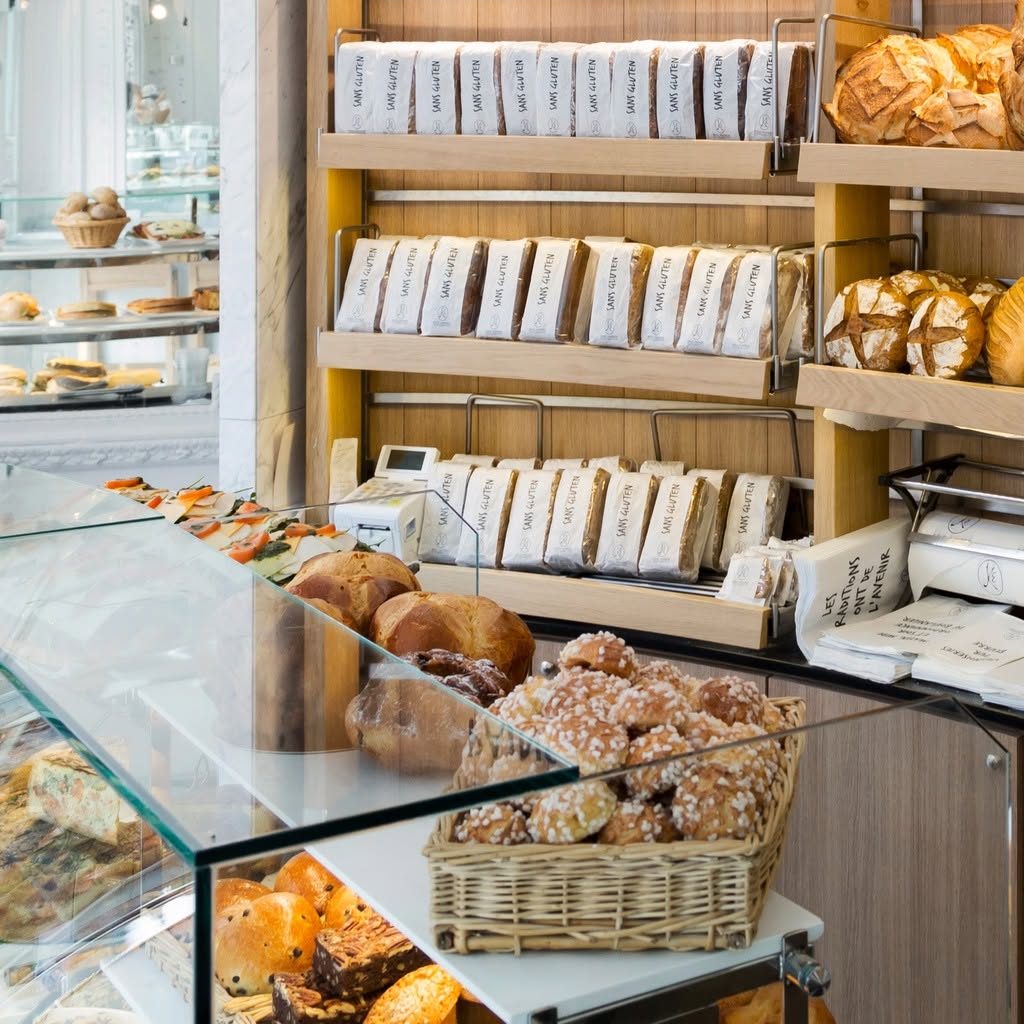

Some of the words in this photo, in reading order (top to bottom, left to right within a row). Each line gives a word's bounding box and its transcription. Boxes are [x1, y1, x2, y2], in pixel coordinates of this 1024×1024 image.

[355, 55, 364, 86] GLUTEN
[388, 59, 400, 89] GLUTEN
[431, 60, 441, 91] GLUTEN
[471, 59, 481, 90] GLUTEN
[514, 59, 525, 90] GLUTEN
[549, 56, 560, 88] GLUTEN
[588, 59, 597, 91] GLUTEN
[626, 60, 636, 91] GLUTEN
[669, 57, 680, 90] GLUTEN
[713, 55, 723, 88] GLUTEN
[353, 89, 362, 108] SANS
[386, 91, 396, 111] SANS
[432, 93, 442, 113] SANS
[473, 93, 483, 113] SANS
[518, 93, 528, 113] SANS
[549, 90, 558, 111] SANS
[589, 93, 598, 113] SANS
[626, 94, 636, 115] SANS
[669, 93, 679, 113] SANS
[713, 92, 723, 111] SANS
[760, 88, 772, 107] SANS
[357, 278, 369, 296] SANS
[364, 247, 378, 277] GLUTEN
[405, 247, 418, 277] GLUTEN
[439, 279, 452, 299] SANS
[446, 247, 459, 278] GLUTEN
[497, 255, 509, 286] GLUTEN
[607, 256, 619, 290] GLUTEN
[658, 257, 672, 290] GLUTEN
[400, 277, 411, 297] SANS
[537, 286, 549, 306] SANS
[543, 253, 555, 285] GLUTEN
[702, 262, 717, 295] GLUTEN
[746, 263, 761, 297] GLUTEN
[492, 288, 504, 307] SANS
[606, 292, 616, 311] SANS
[654, 293, 665, 312] SANS
[697, 297, 708, 317] SANS
[742, 299, 754, 319] SANS
[481, 479, 494, 509] GLUTEN
[527, 479, 539, 510] GLUTEN
[562, 505, 575, 525] SANS
[569, 475, 581, 504] GLUTEN
[622, 483, 634, 515] GLUTEN
[667, 483, 681, 514] GLUTEN
[743, 481, 755, 514] GLUTEN
[438, 506, 450, 526] SANS
[476, 510, 488, 531] SANS
[523, 511, 534, 531] SANS
[616, 518, 629, 537] SANS
[661, 514, 674, 534] SANS
[738, 515, 749, 534] SANS
[853, 587, 867, 615] ONT
[860, 566, 874, 584] DE
[868, 548, 891, 613] L'AVENIR
[822, 593, 837, 617] LES
